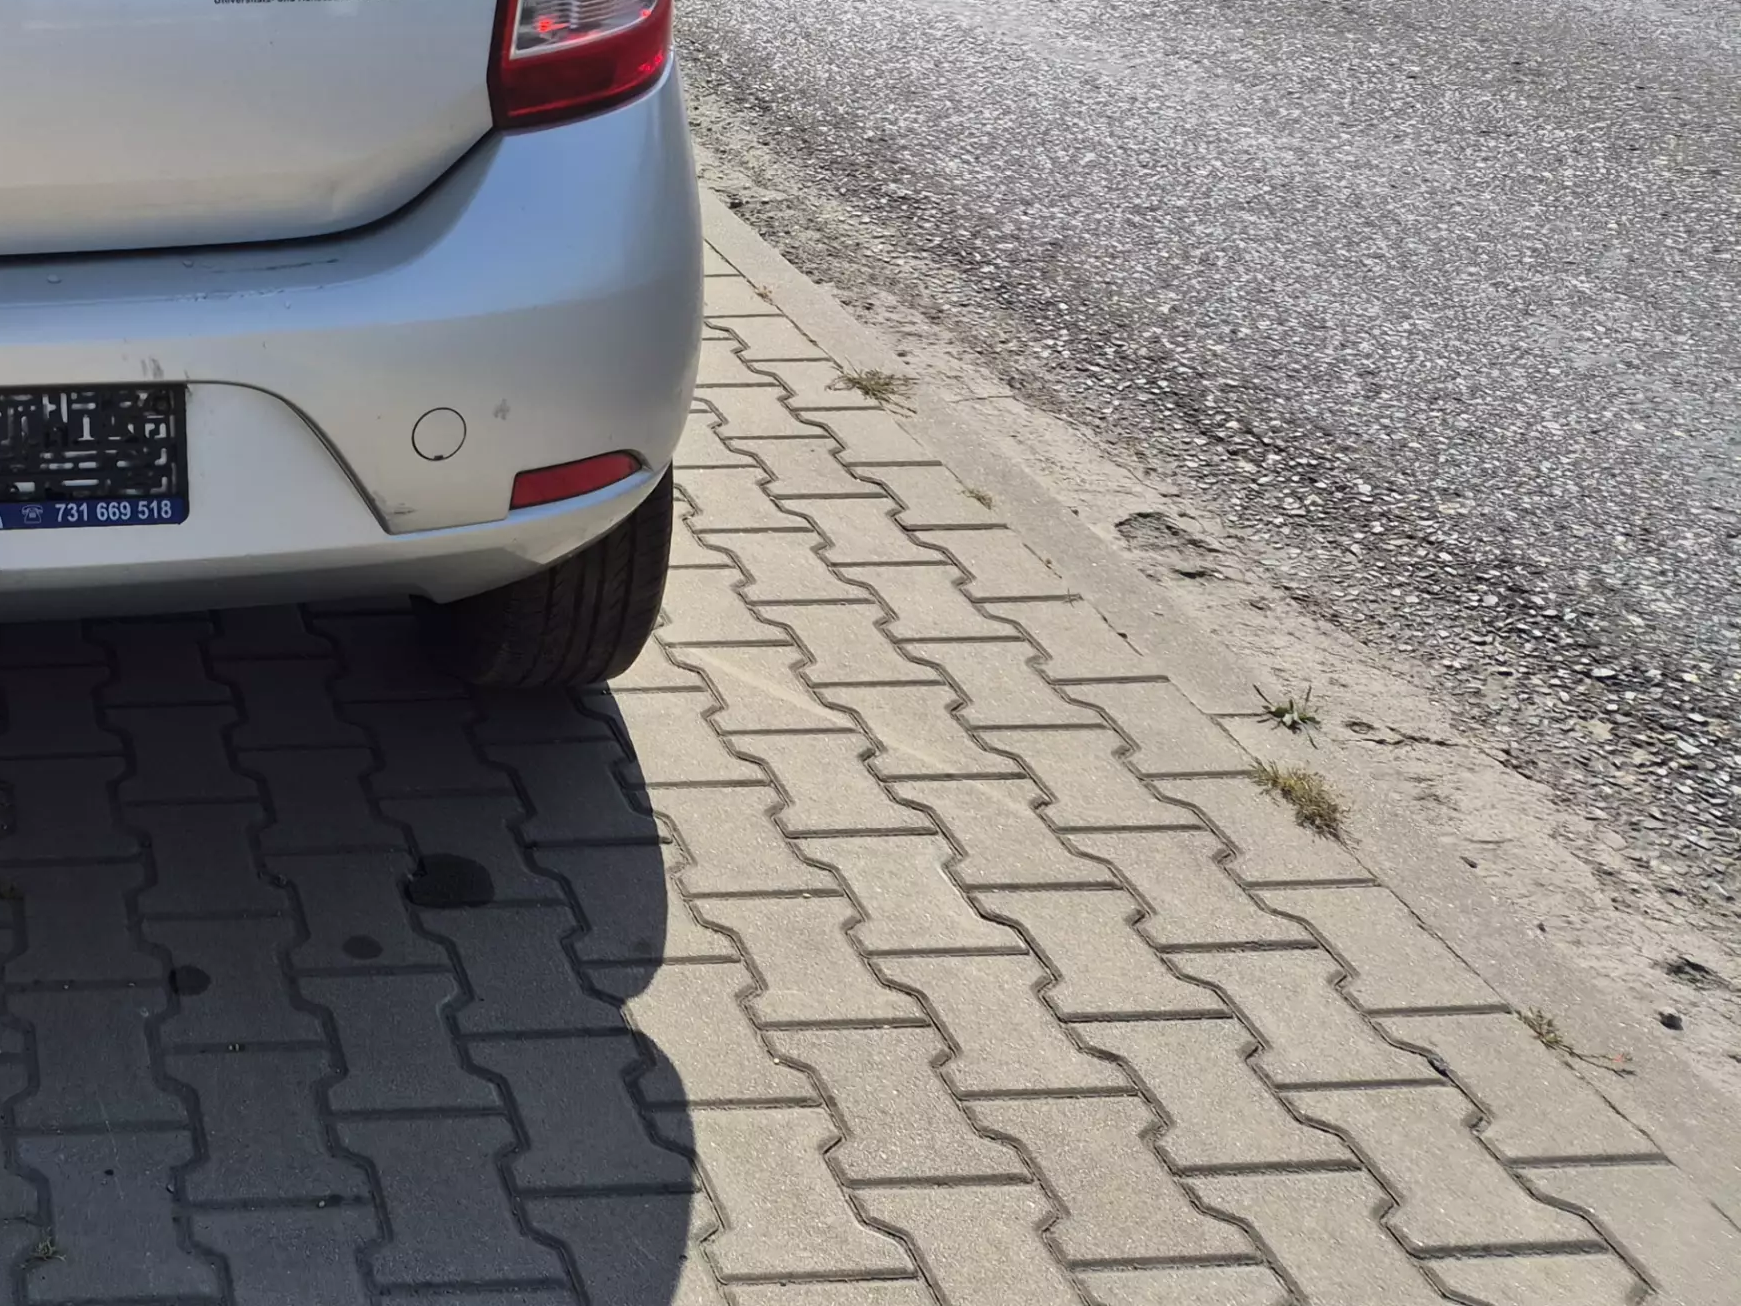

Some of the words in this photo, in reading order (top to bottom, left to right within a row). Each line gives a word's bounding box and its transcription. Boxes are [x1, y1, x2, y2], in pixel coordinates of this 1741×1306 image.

[55, 502, 88, 522] 731
[96, 501, 131, 521] 669
[138, 500, 173, 520] 518
